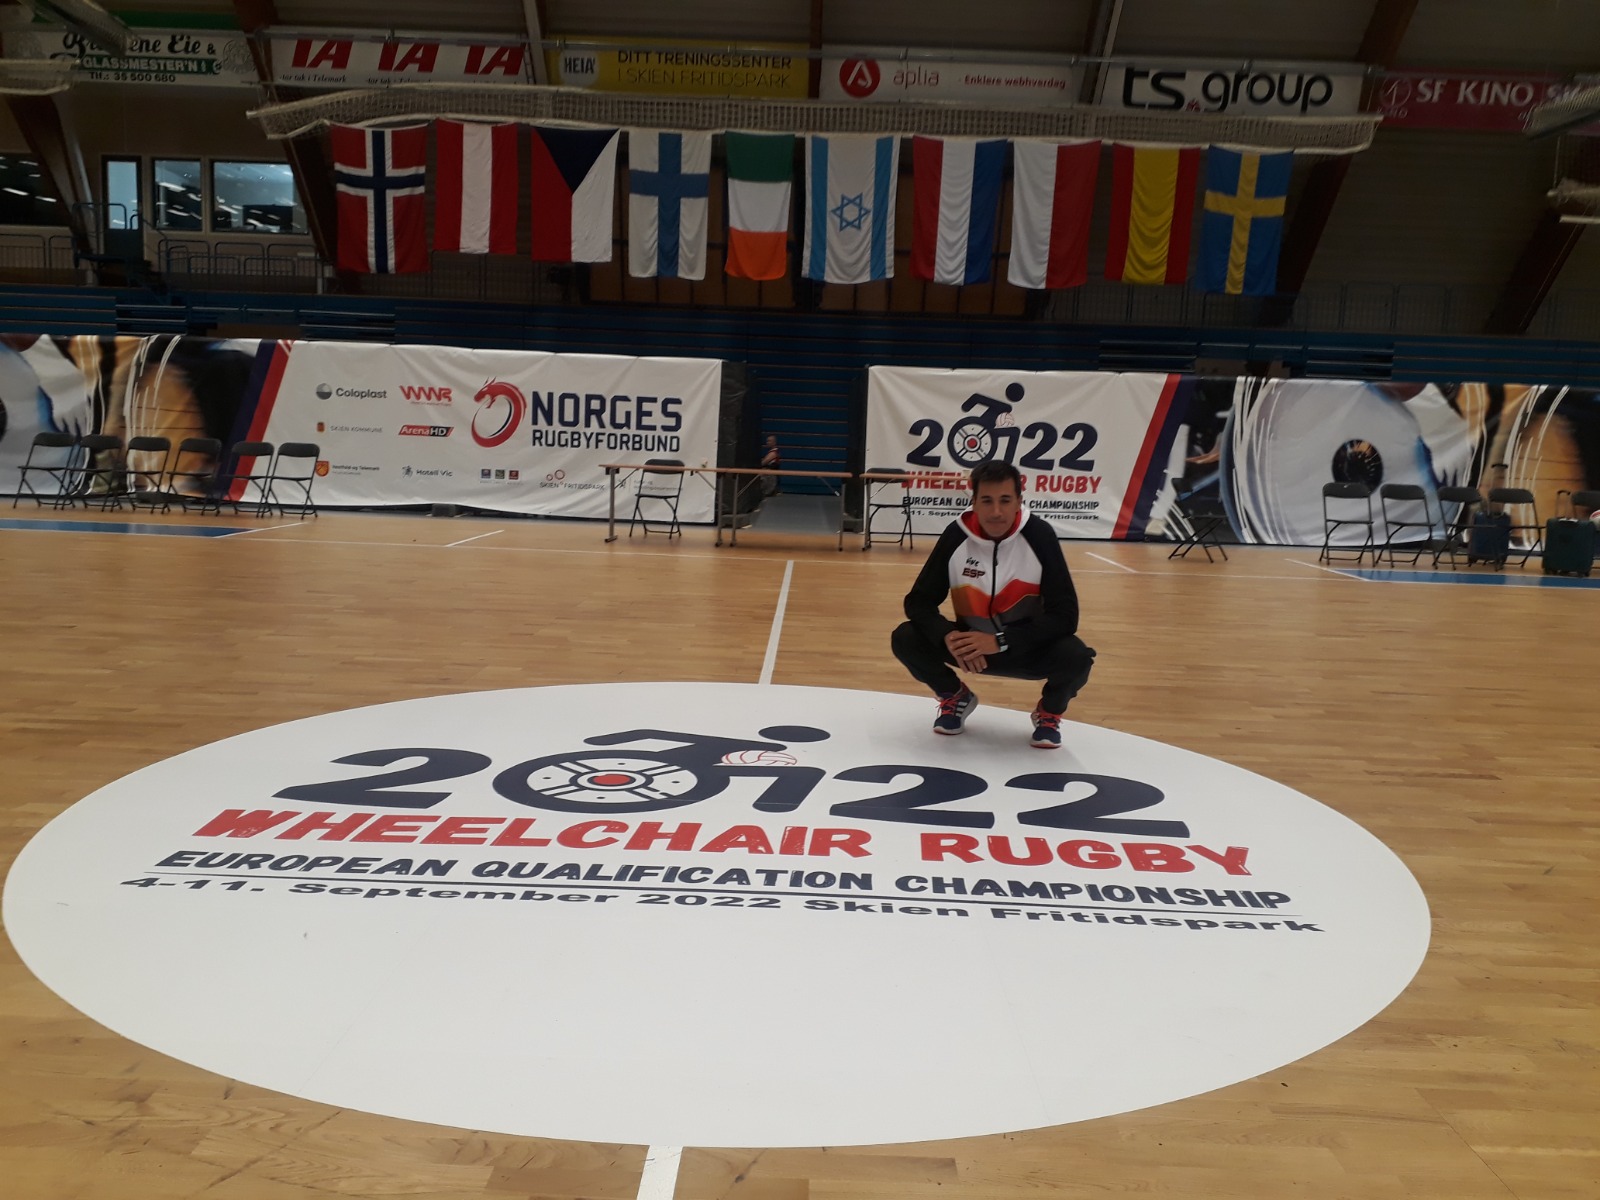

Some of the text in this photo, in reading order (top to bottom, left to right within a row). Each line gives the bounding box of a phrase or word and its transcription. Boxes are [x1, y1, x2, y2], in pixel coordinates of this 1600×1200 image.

[168, 34, 200, 54] Eie
[206, 43, 216, 54] &
[617, 50, 792, 69] DITT TRENINGSSENTER
[114, 72, 127, 81] 35
[626, 69, 675, 84] SKIEN
[680, 70, 792, 88] FRITIDSPARK
[893, 66, 940, 89] aplia
[964, 75, 1002, 85] Enklere
[1416, 78, 1448, 103] SF
[1456, 80, 1535, 107] KINO
[336, 387, 387, 399] Coloplast
[531, 390, 683, 432] NORGES
[400, 425, 448, 437] ArenaHD
[532, 429, 681, 453] RUGBYFORBUND
[1035, 475, 1102, 494] RUGBY
[902, 496, 953, 507] EUROPEAN
[1029, 500, 1100, 510] CHAMPIONSHIP
[1044, 513, 1100, 521] Fritidspark
[962, 567, 986, 578] ESP
[192, 809, 1252, 876] WHEELCHAIR RUGBY
[154, 851, 1292, 909] EUROPEAN QUALIFICATION CHAMPIONSHIP
[120, 877, 1324, 932] 4-11. September 2022 Skien Fritidspark
